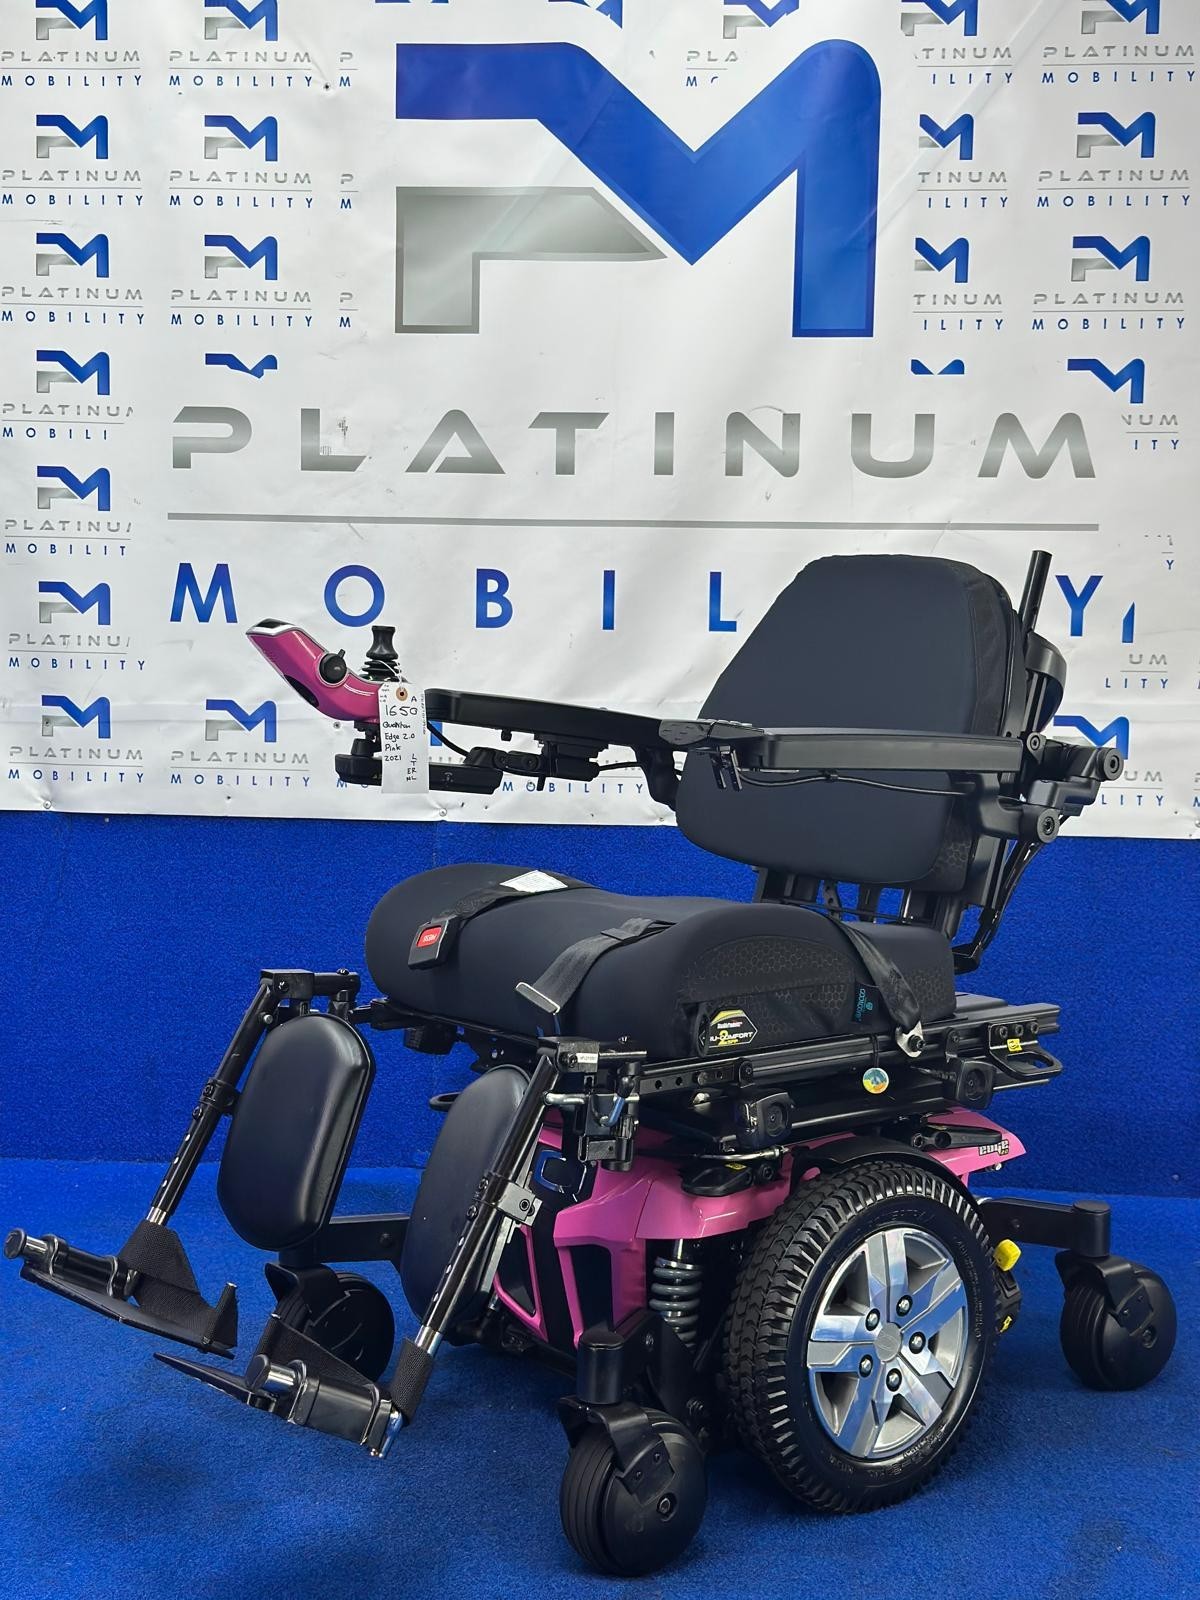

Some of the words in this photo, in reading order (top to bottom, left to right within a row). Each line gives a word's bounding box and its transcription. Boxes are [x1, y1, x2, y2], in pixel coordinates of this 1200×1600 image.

[1, 50, 139, 62] PLATINUM
[169, 50, 311, 62] PLATINUM
[914, 47, 1011, 59] TINUM
[1042, 44, 1194, 58] PLATINUM
[1, 74, 141, 86] MOBILITY
[168, 74, 312, 87] MOBILITY
[1041, 70, 1195, 83] MOBILITY
[2, 169, 140, 181] PLATINUM
[169, 170, 311, 184] PLATINUM
[1038, 169, 1189, 182] PLATINUM
[1, 193, 142, 205] MOBILITY
[169, 194, 312, 208] MOBILITY
[1036, 194, 1190, 207] MOBILITY
[1, 285, 142, 300] PLATINUM
[170, 289, 310, 302] PLATINUM
[1033, 291, 1183, 304] PLATINUM
[1, 310, 144, 324] MOBILITY
[170, 313, 312, 327] MOBILITY
[1031, 317, 1184, 330] MOBILITY
[2, 426, 106, 440] MOBILI
[171, 406, 1096, 478] PLATINUM
[5, 542, 125, 556] MOBILIT
[170, 563, 1103, 637] MOBILY
[8, 632, 129, 647] PLATINU
[8, 656, 144, 670] MOBILITY
[385, 705, 418, 716] 1650
[384, 732, 400, 742] Edge
[9, 745, 142, 760] PLATINUM
[385, 743, 401, 752] Pink
[170, 750, 308, 764] PLATINUM
[8, 768, 143, 783] MOBILITY
[170, 773, 309, 786] MOBILITY
[502, 781, 644, 794] MOBILITY
